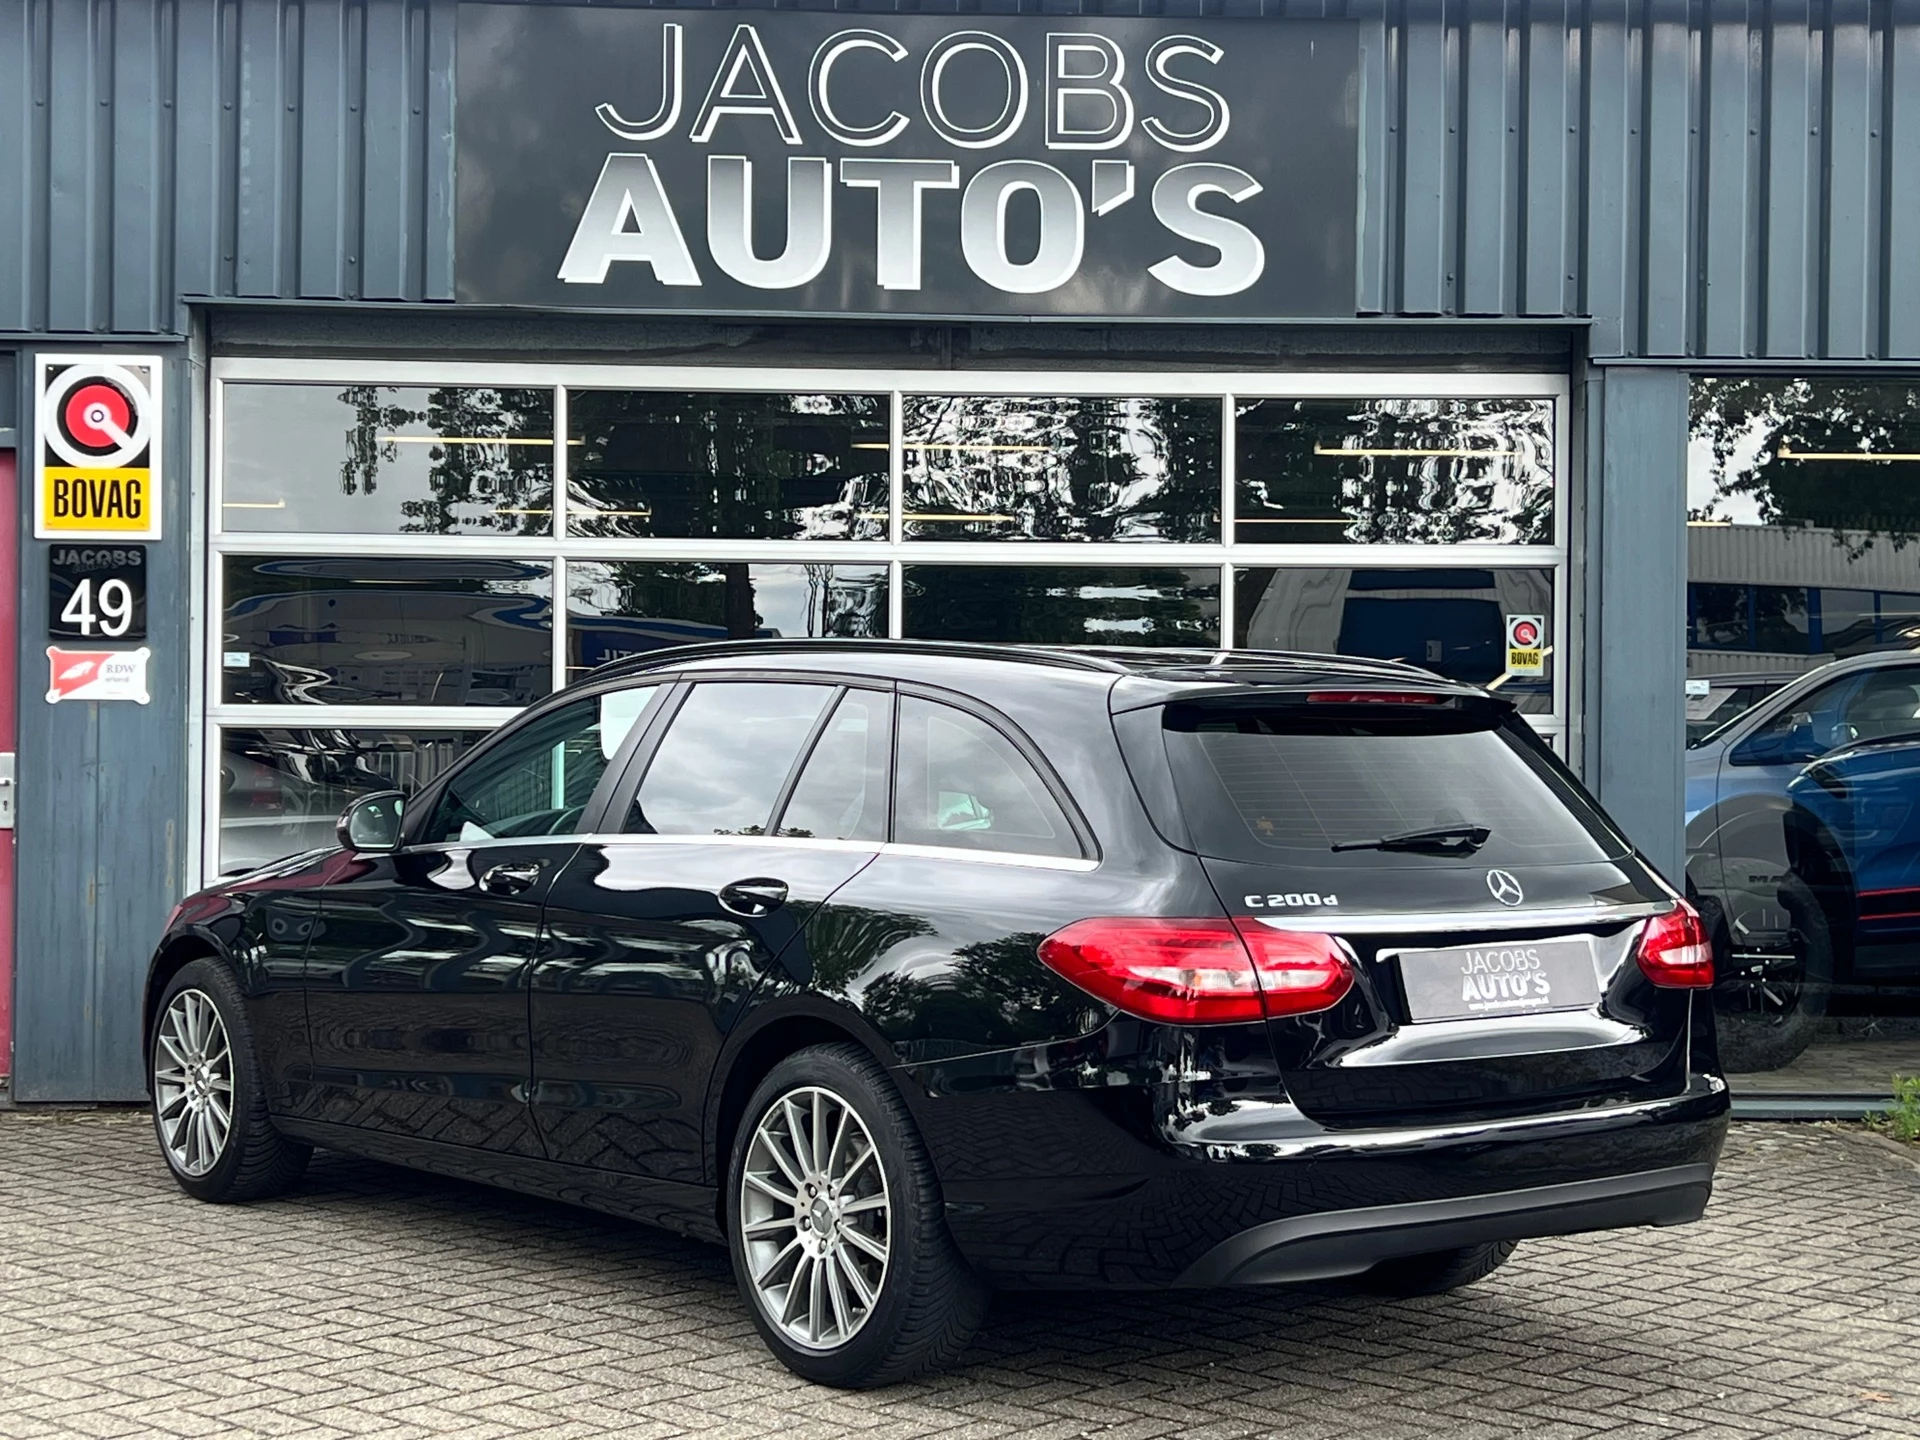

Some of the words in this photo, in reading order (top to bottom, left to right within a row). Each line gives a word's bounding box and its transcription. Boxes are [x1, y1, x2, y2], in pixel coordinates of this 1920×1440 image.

[594, 23, 1232, 153] JACOBS
[557, 152, 1266, 297] AUTO'S
[53, 478, 142, 519] BOVAG
[52, 549, 142, 566] JACOBS
[60, 578, 133, 637] 49
[106, 664, 136, 674] RDW
[1511, 652, 1539, 665] BOVAG
[1244, 895, 1264, 908] C
[1266, 892, 1339, 907] 200d
[1461, 948, 1541, 975] JACOBS
[1462, 970, 1551, 1002] AUTO'S
